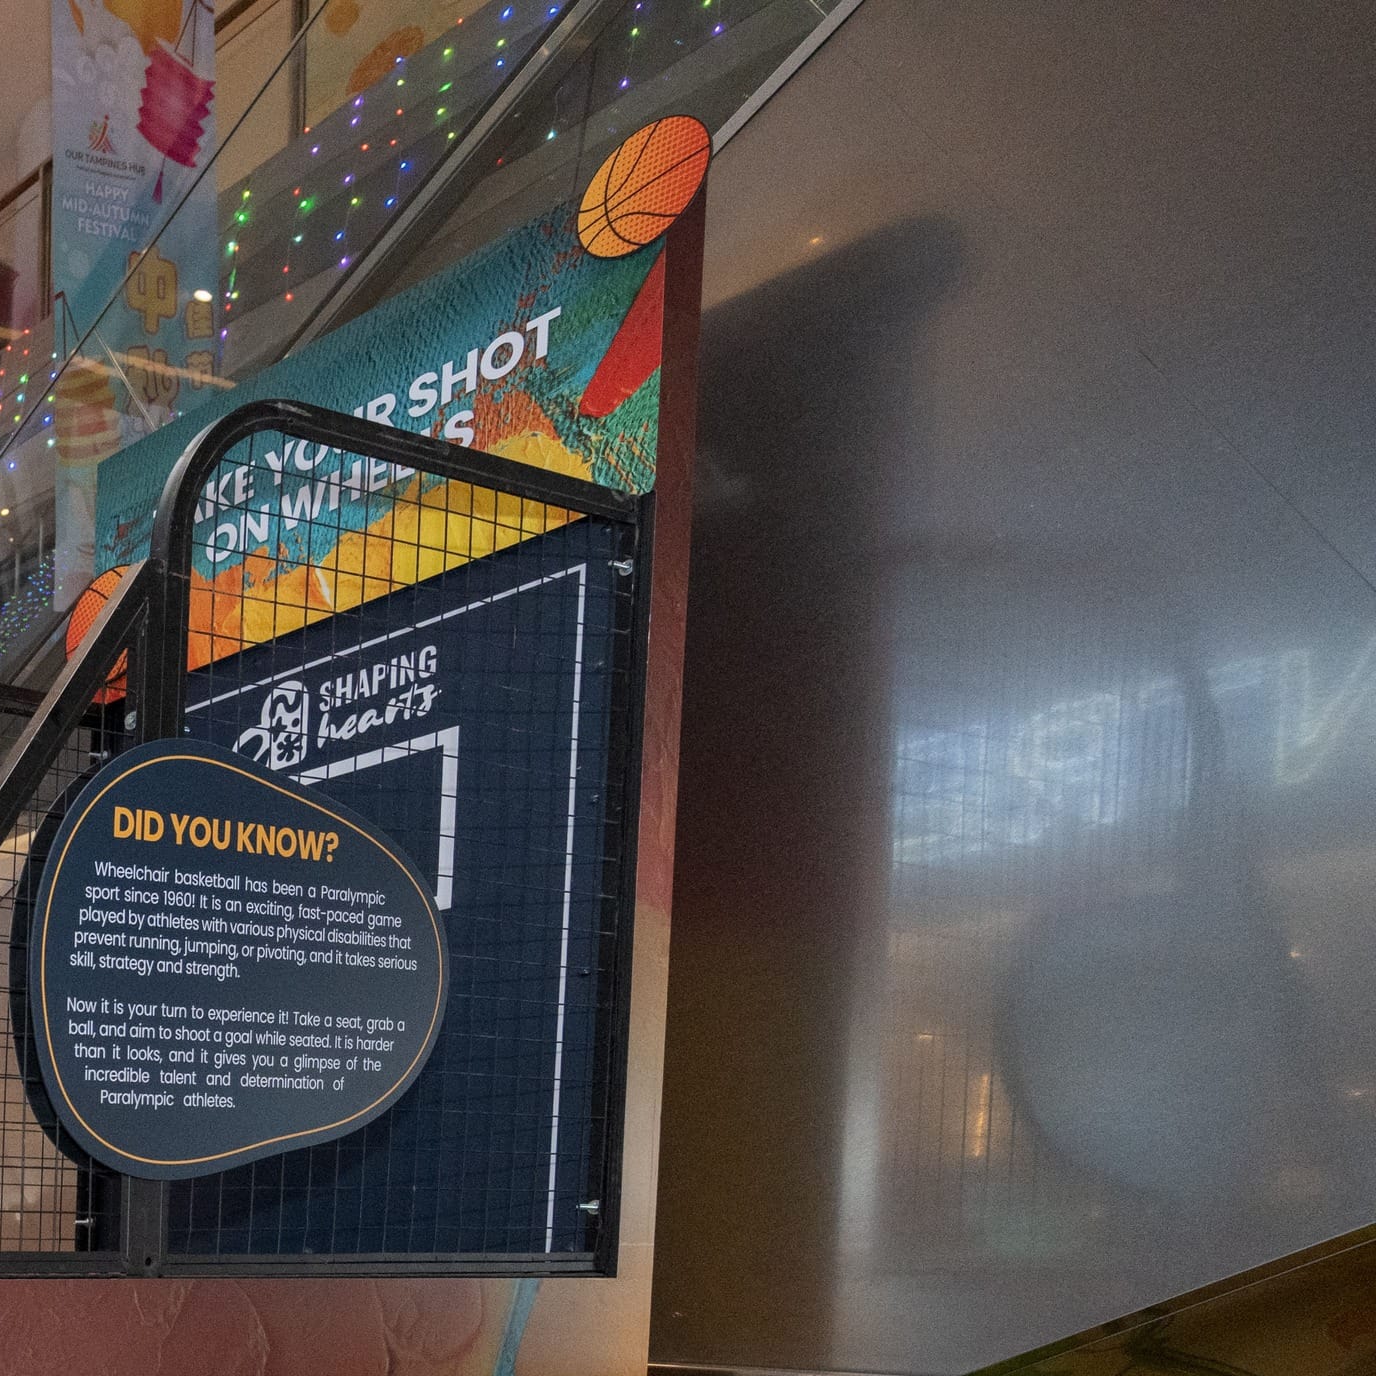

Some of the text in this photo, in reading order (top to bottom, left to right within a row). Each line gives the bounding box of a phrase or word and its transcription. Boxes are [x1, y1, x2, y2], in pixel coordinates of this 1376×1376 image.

[65, 148, 86, 164] OUR
[86, 152, 128, 173] TAMPINES
[128, 163, 146, 176] HUB
[85, 181, 129, 202] HAPPY
[77, 217, 138, 241] FESTIVAL
[408, 306, 562, 419] SHOT
[205, 503, 270, 564] ON
[319, 645, 438, 712] SHAPING
[317, 683, 443, 749] hearts
[113, 806, 339, 863] DID YOU KNOW?
[94, 861, 386, 908] Wheelchair basketball has been a Paralympic
[85, 886, 402, 929] sport since 1960! It is an exciting, fast-paced game
[79, 906, 411, 950] played by athletes with various physical disabilities that
[70, 951, 240, 981] skill, strategy and strength.
[74, 930, 417, 971] prevent running, jumping, or pivoting, and it takes serious
[67, 996, 405, 1034] Now it is your turn to experience it! Take a seat, grab a
[68, 1019, 394, 1052] ball, and aim to shoot a goal while seated. It is harder
[74, 1043, 381, 1072] than it looks, and it gives you a glimpse of the
[85, 1065, 344, 1090] incredible talent and determination of
[100, 1089, 236, 1110] Paralympic athletes.
